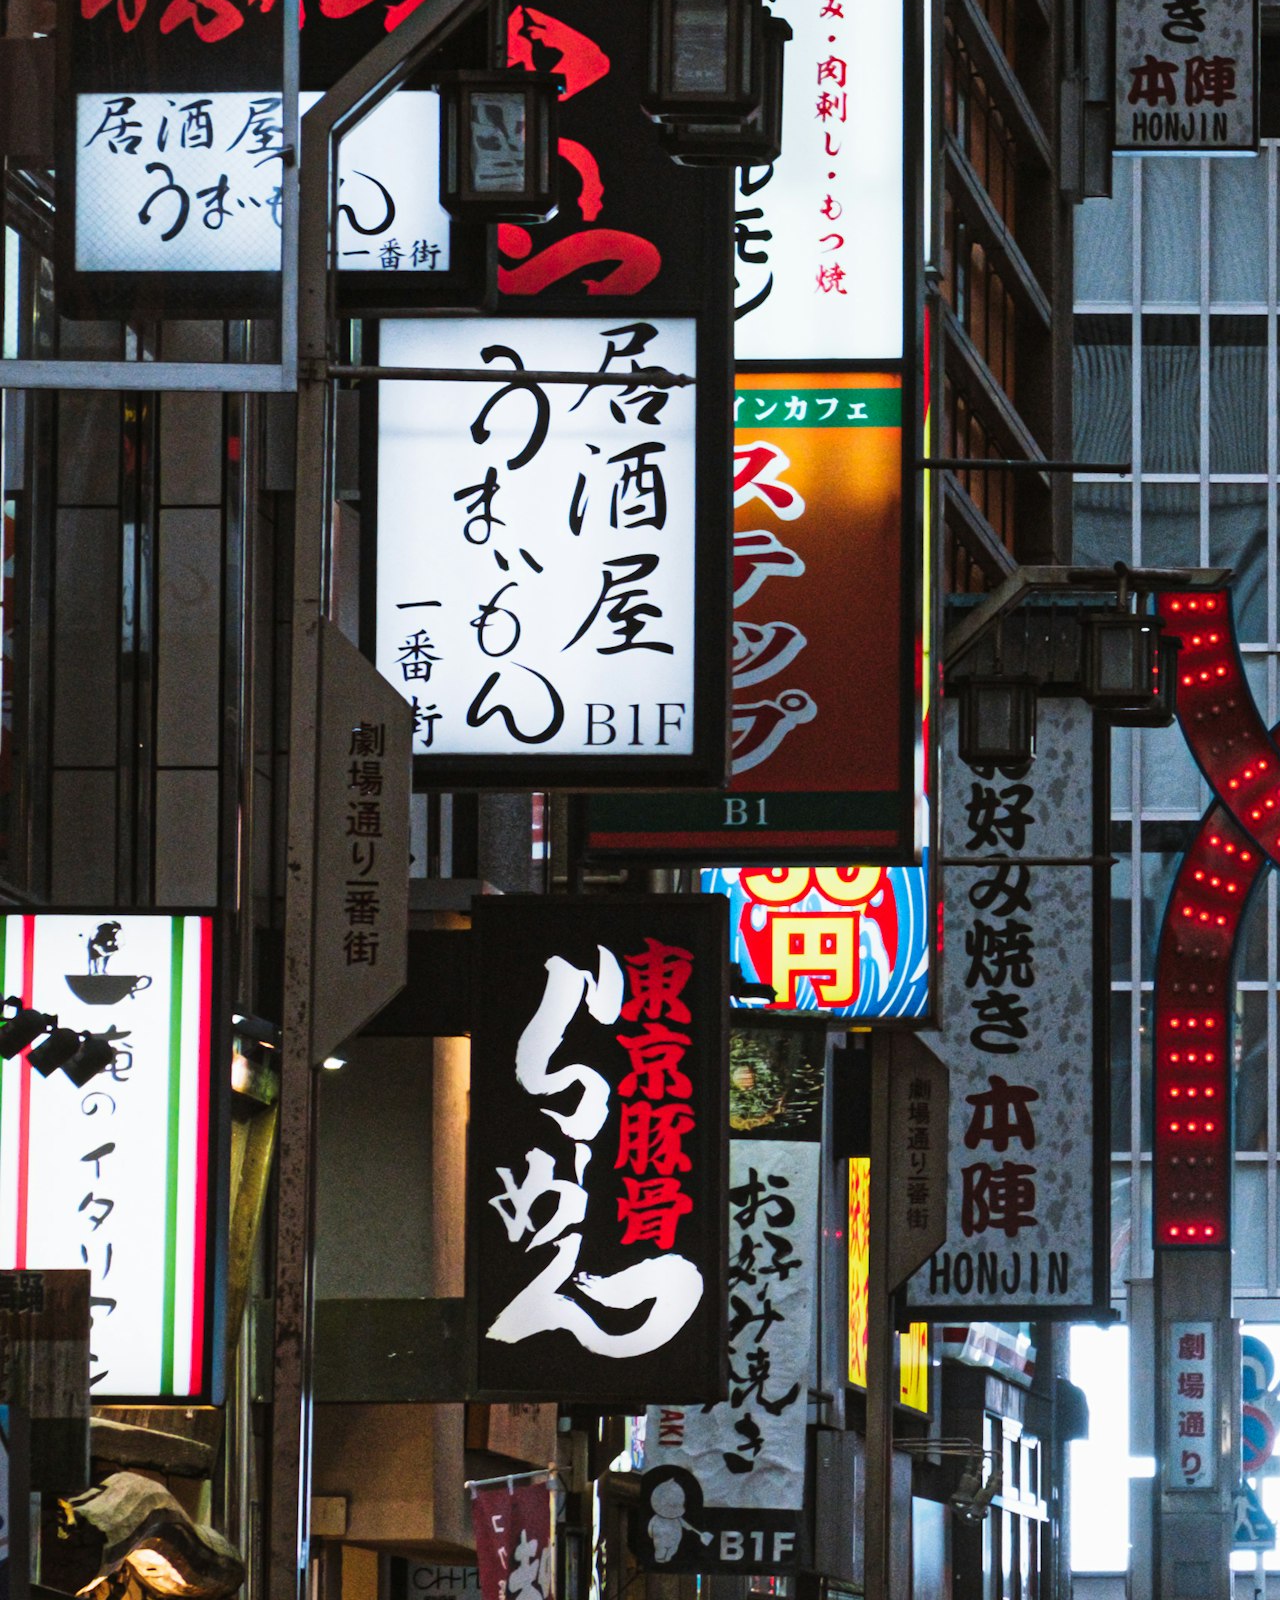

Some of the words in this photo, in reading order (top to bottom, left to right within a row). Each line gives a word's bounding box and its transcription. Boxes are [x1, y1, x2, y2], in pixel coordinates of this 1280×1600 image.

[84, 96, 285, 169] 居酒屋
[1127, 54, 1238, 108] 本陣
[1132, 111, 1228, 143] HONJIN
[453, 344, 566, 746] うまいもん
[560, 322, 675, 656] 居酒屋
[583, 703, 687, 748] B1F
[343, 721, 386, 968] 劇場通り一番街
[723, 798, 770, 826] B1
[963, 759, 1037, 1055] 好み焼き
[612, 936, 696, 1251] 東京豚骨
[906, 1077, 932, 1231] 劇場通り一番街
[960, 1074, 1040, 1239] 本陣
[722, 1166, 802, 1475] お好み焼き
[928, 1250, 1070, 1298] HONJIN
[1176, 1331, 1207, 1478] 劇場通り
[720, 1530, 797, 1563] B1F
